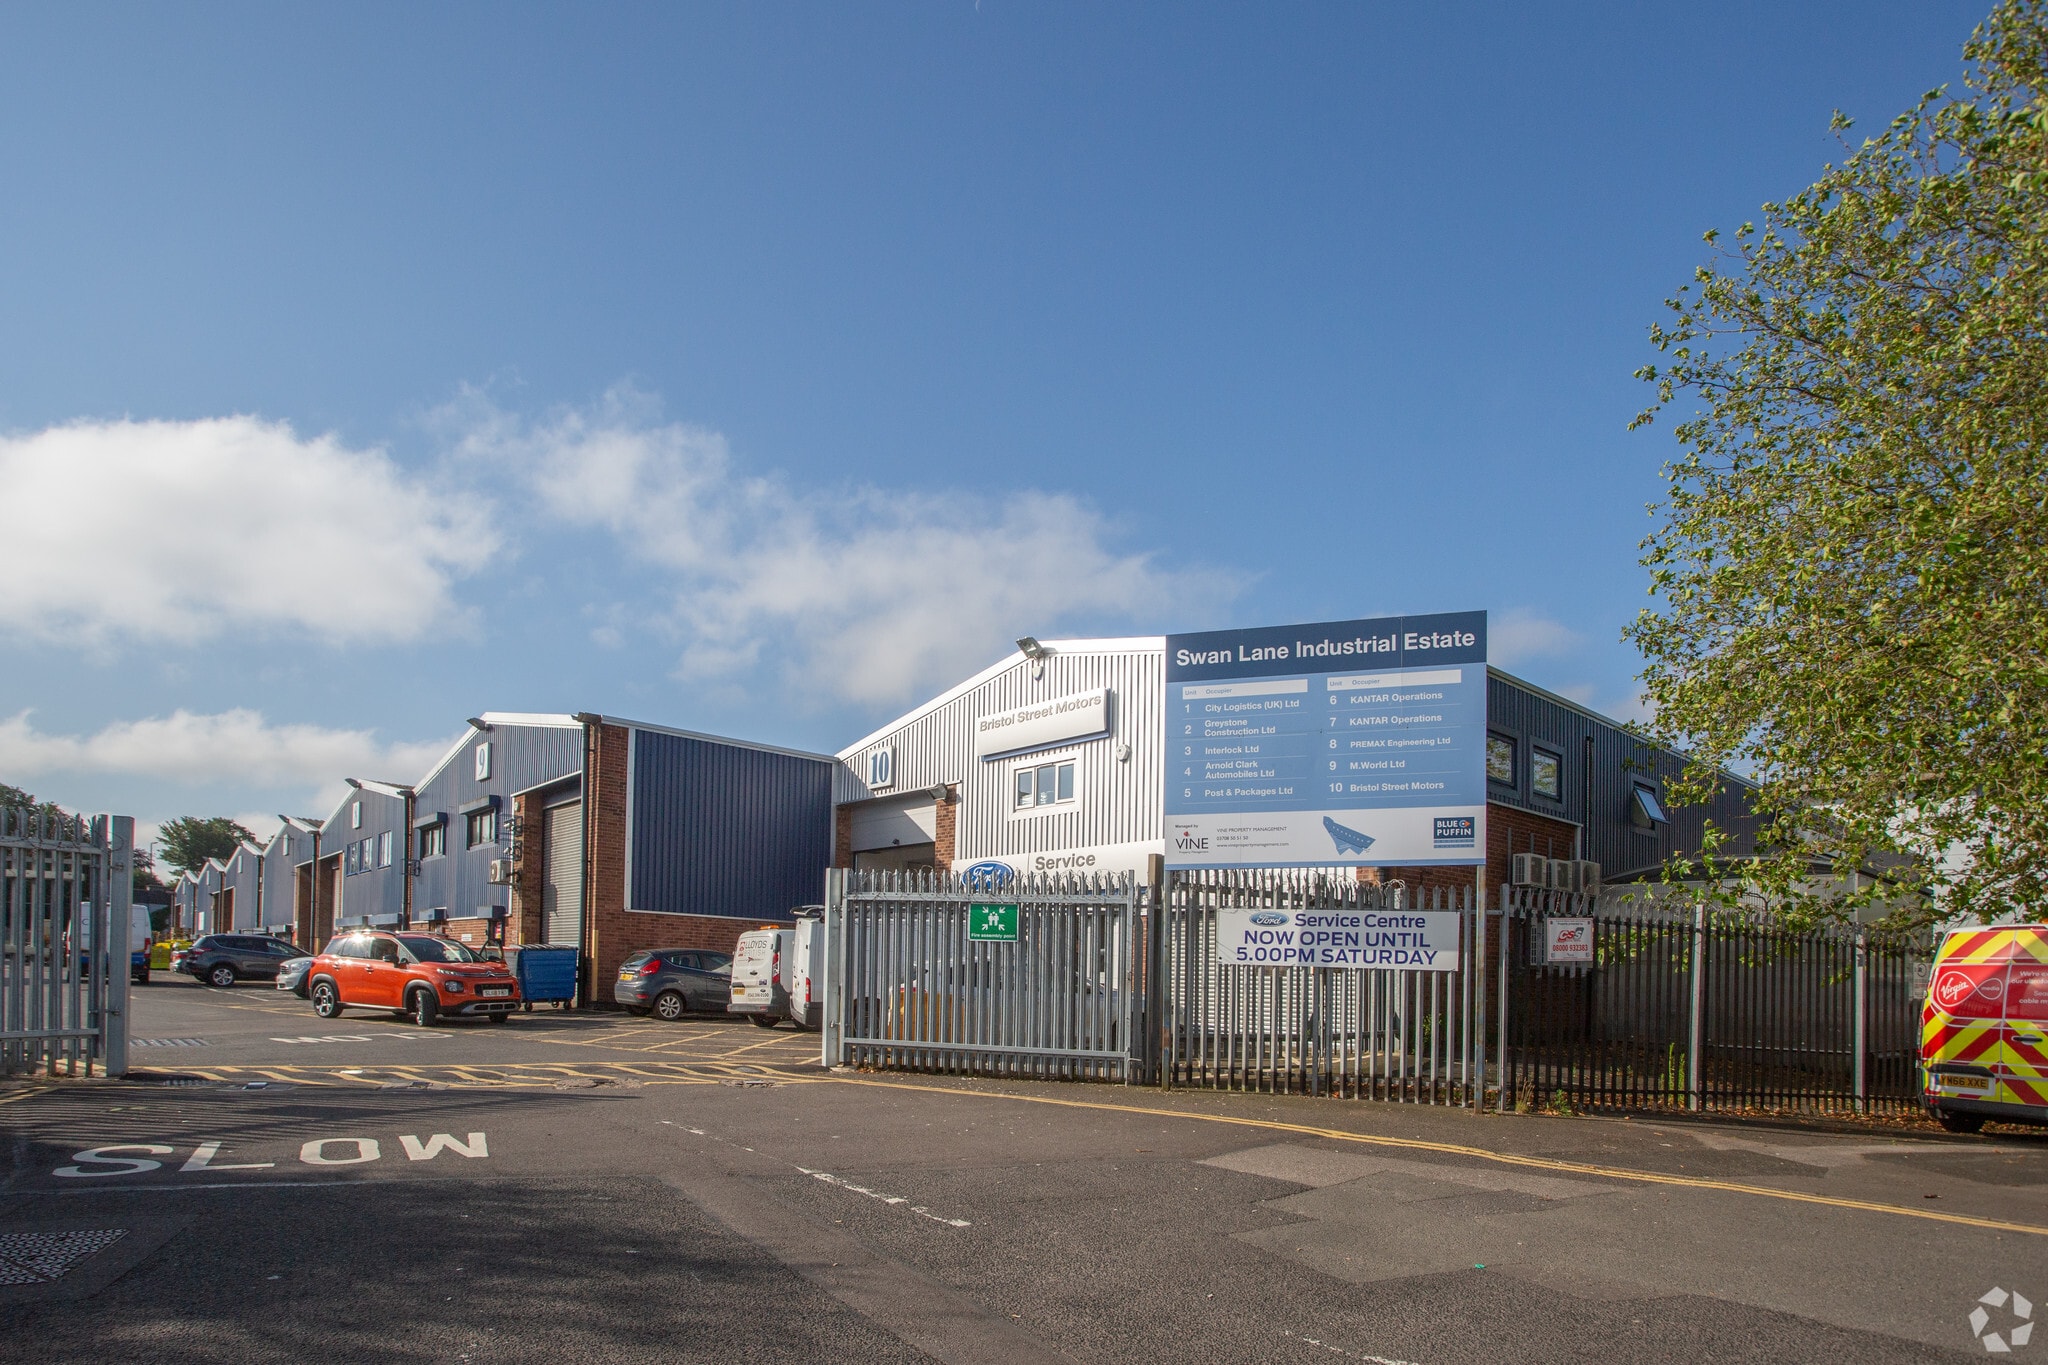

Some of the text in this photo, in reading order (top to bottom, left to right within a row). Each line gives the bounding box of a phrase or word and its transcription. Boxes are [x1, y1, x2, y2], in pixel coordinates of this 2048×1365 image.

[1176, 630, 1476, 666] Swan Lane Industrial Estate
[1206, 688, 1232, 696] Occupier
[1330, 692, 1443, 705] 6 KANTAR Operations
[1185, 705, 1190, 713] 1
[1224, 702, 1262, 712] Logistics
[1264, 701, 1282, 710] (UK)
[1285, 700, 1300, 708] Ltd
[980, 696, 1102, 732] Bristol Street Motors
[1205, 719, 1247, 728] Greystone
[1330, 714, 1442, 727] 7 KANTAR Operations
[1185, 726, 1191, 734] 2
[1205, 727, 1259, 737] Construction
[1330, 739, 1337, 749] 8
[1350, 740, 1385, 748] PREMAX
[1388, 738, 1434, 748] Engineering
[1185, 746, 1191, 755] 3
[1205, 746, 1242, 754] Interlock
[478, 748, 485, 776] 9
[870, 750, 891, 783] 10
[1206, 761, 1233, 769] Arnold
[1329, 761, 1337, 770] 9
[1350, 761, 1387, 770] M.World
[1184, 768, 1191, 776] 4
[1205, 770, 1258, 779] Automobiles
[1329, 781, 1444, 792] 10 Bristol Street Motors
[1184, 789, 1191, 797] 5
[1234, 788, 1276, 797] Packages
[1437, 820, 1458, 828] BLUE
[1175, 838, 1209, 850] VINE
[1035, 854, 1095, 870] Service
[1256, 913, 1426, 928] Ford Service Centre
[746, 940, 767, 949] LLOYDS
[1244, 930, 1431, 948] NOW OPEN UNTIL
[1236, 947, 1438, 965] 5.00PM SATURDAY
[1941, 978, 1969, 1000] Virgin
[1968, 1078, 1986, 1087] XXE
[52, 1132, 488, 1178] SLOW
